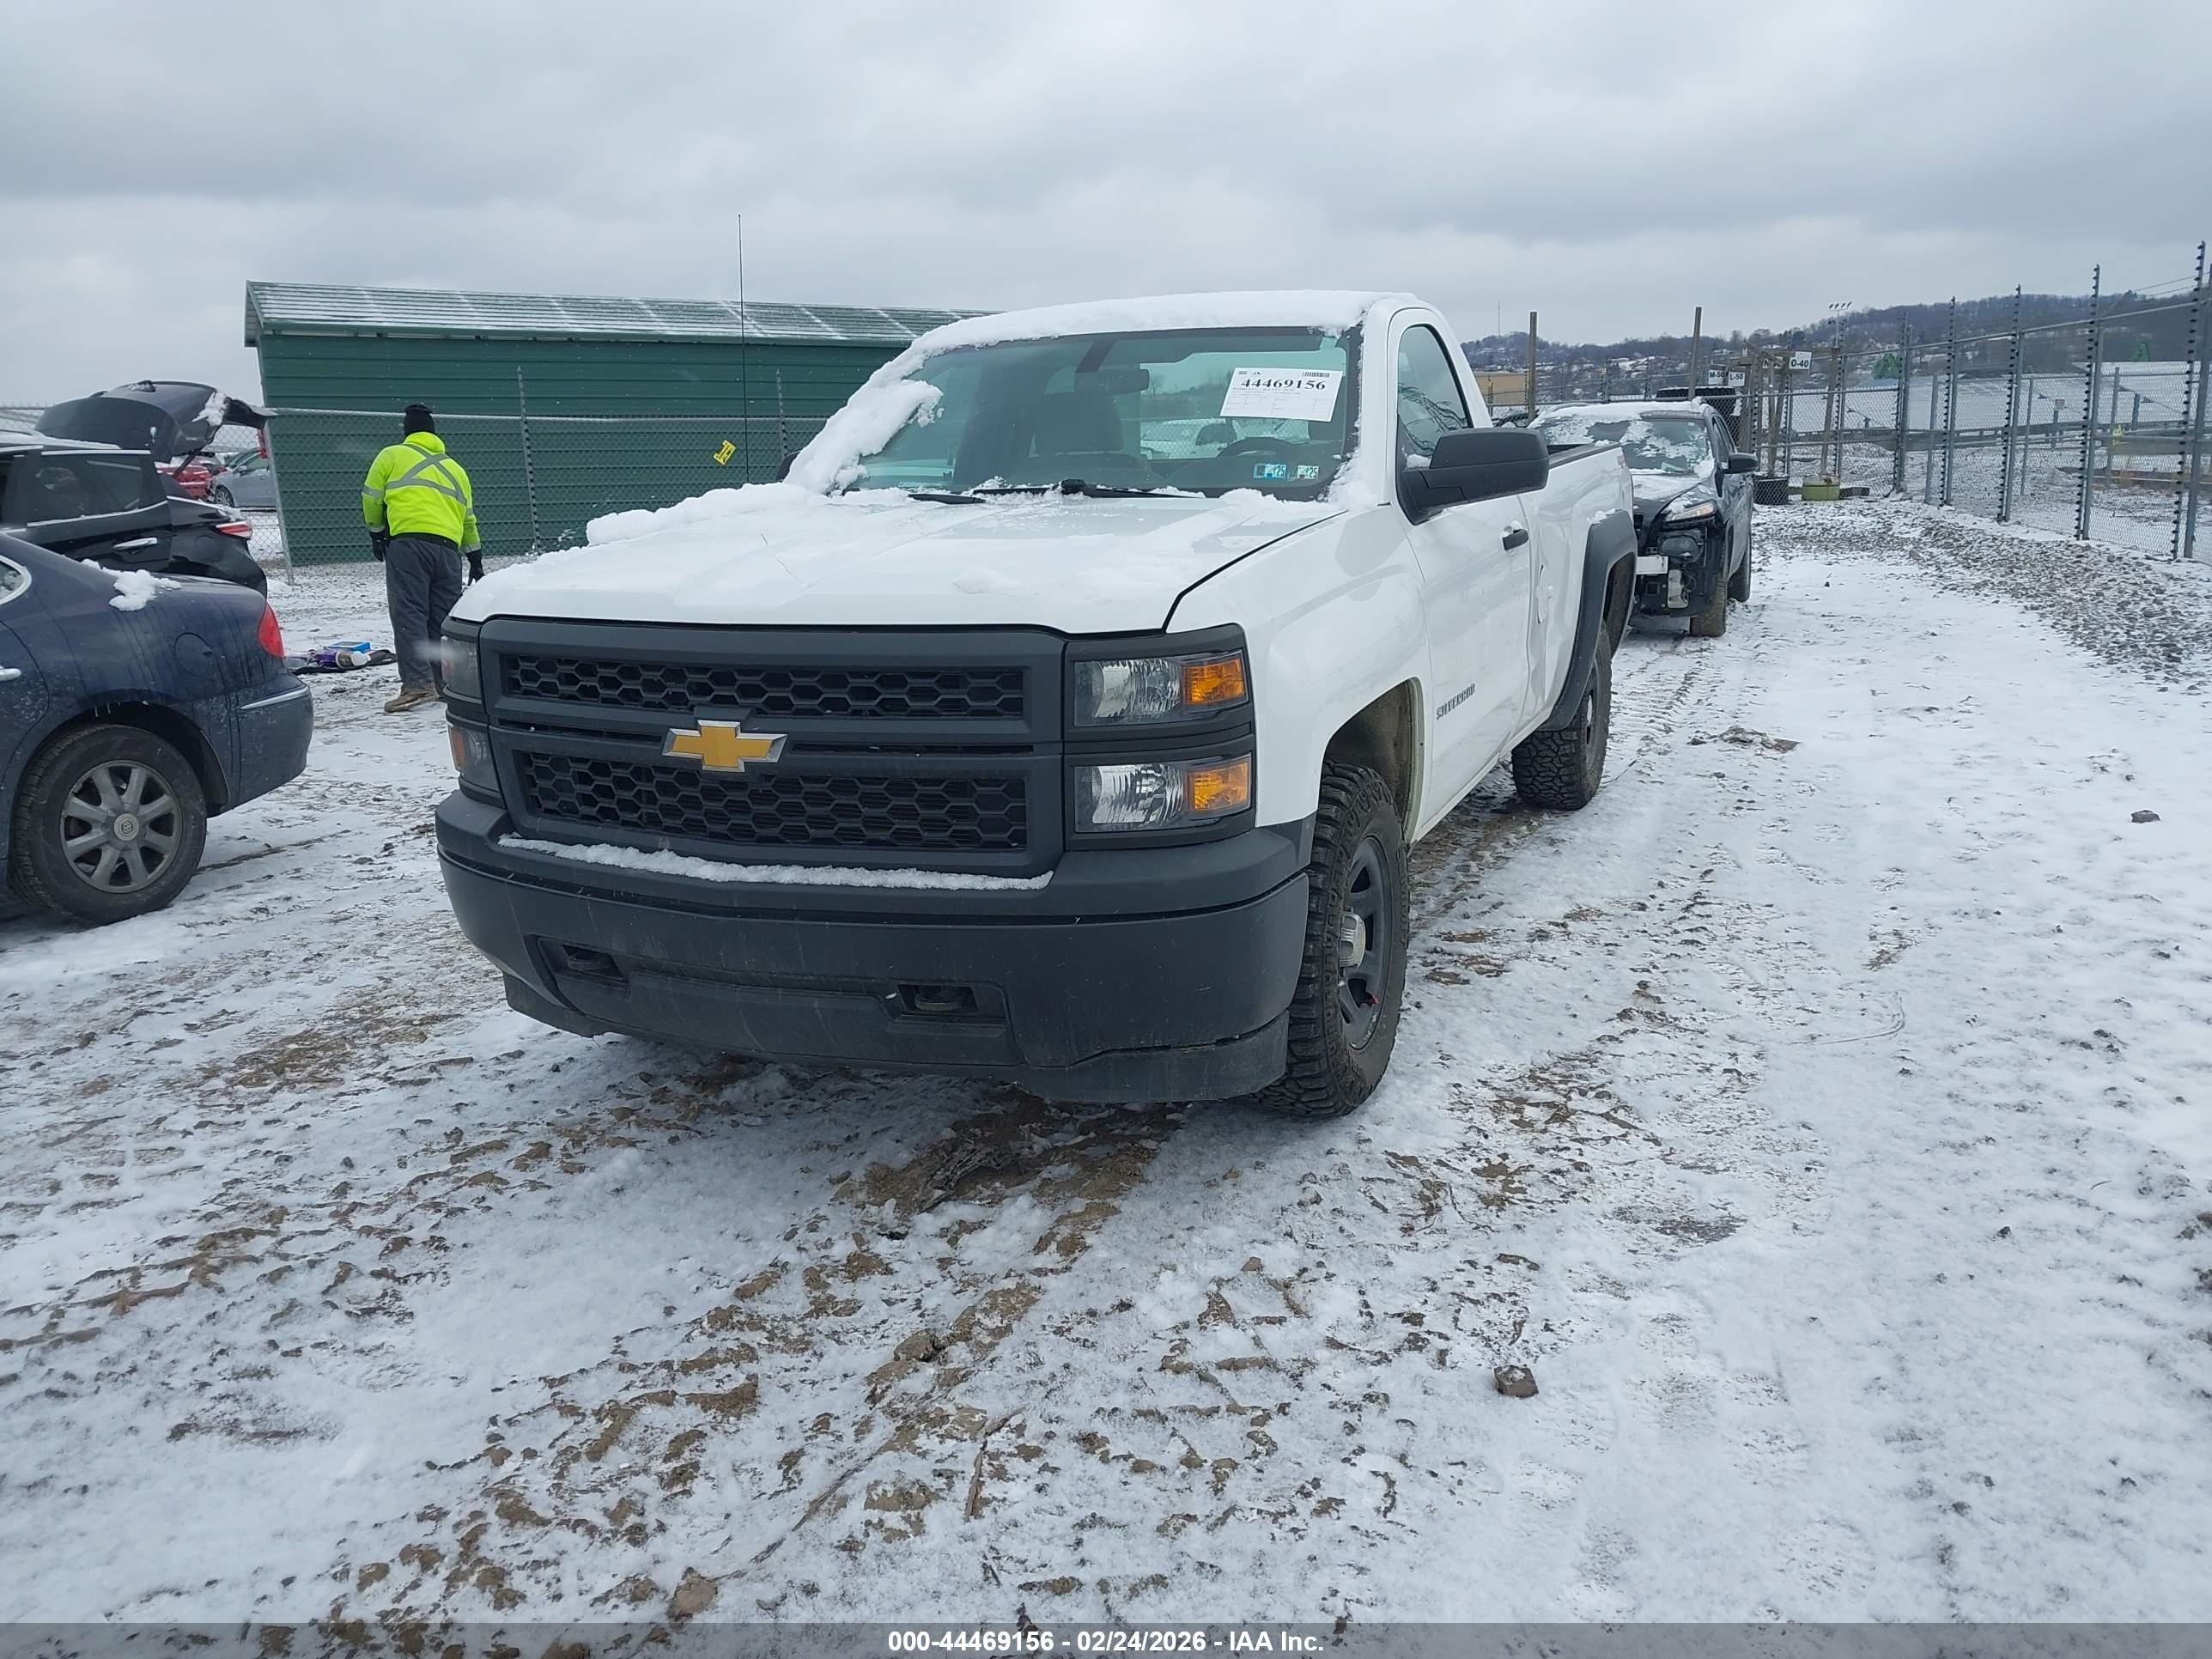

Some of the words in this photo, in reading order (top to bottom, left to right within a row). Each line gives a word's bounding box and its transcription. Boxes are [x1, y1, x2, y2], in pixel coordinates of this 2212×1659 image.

[1791, 359, 1809, 368] O-40
[1241, 378, 1327, 391] 44469156
[1277, 465, 1285, 477] 25
